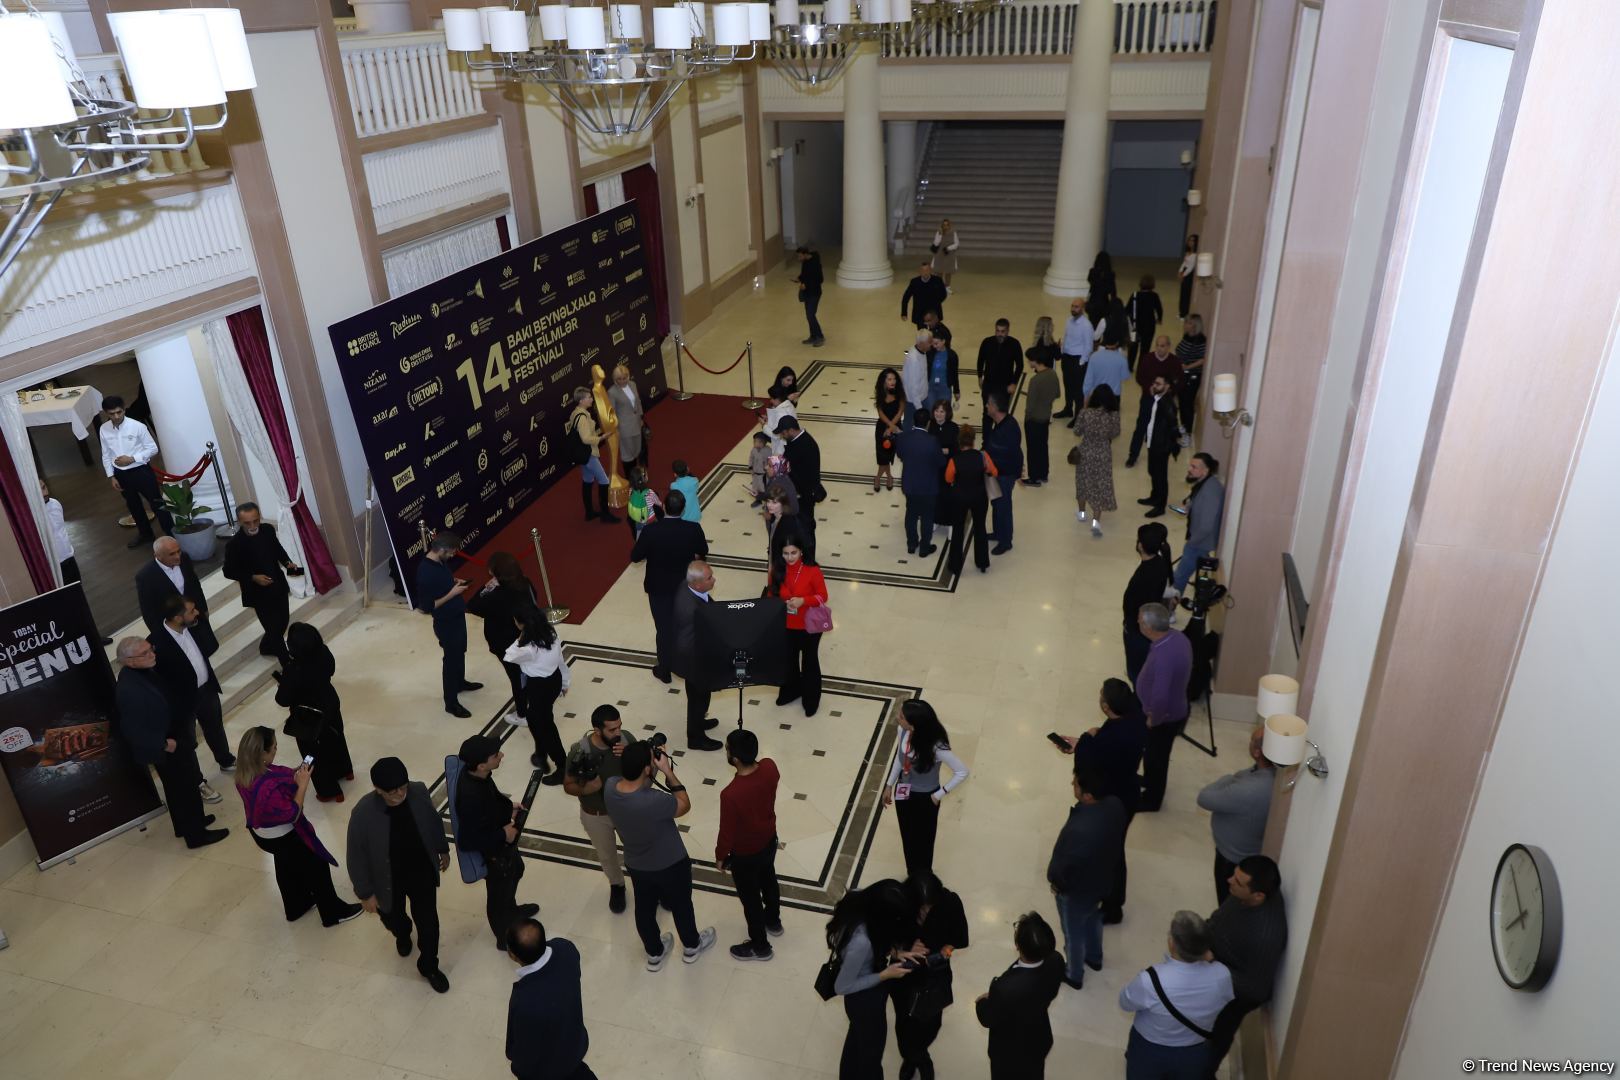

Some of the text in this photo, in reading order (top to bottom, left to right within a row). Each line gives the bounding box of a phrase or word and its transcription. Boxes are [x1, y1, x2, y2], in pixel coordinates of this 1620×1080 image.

[390, 314, 422, 339] Radisson
[507, 325, 532, 349] BAKI
[533, 291, 596, 334] BEYNƏLXALQ
[358, 331, 378, 346] BRITISH
[360, 337, 381, 351] COUNCIL
[511, 342, 536, 365] QISA
[537, 313, 578, 353] FİLMLƏR
[514, 338, 564, 383] FESTİVALI
[364, 373, 386, 389] NIZAMI
[456, 342, 512, 410] 14
[385, 443, 406, 460] Day.Az
[13, 624, 37, 639] TODAY
